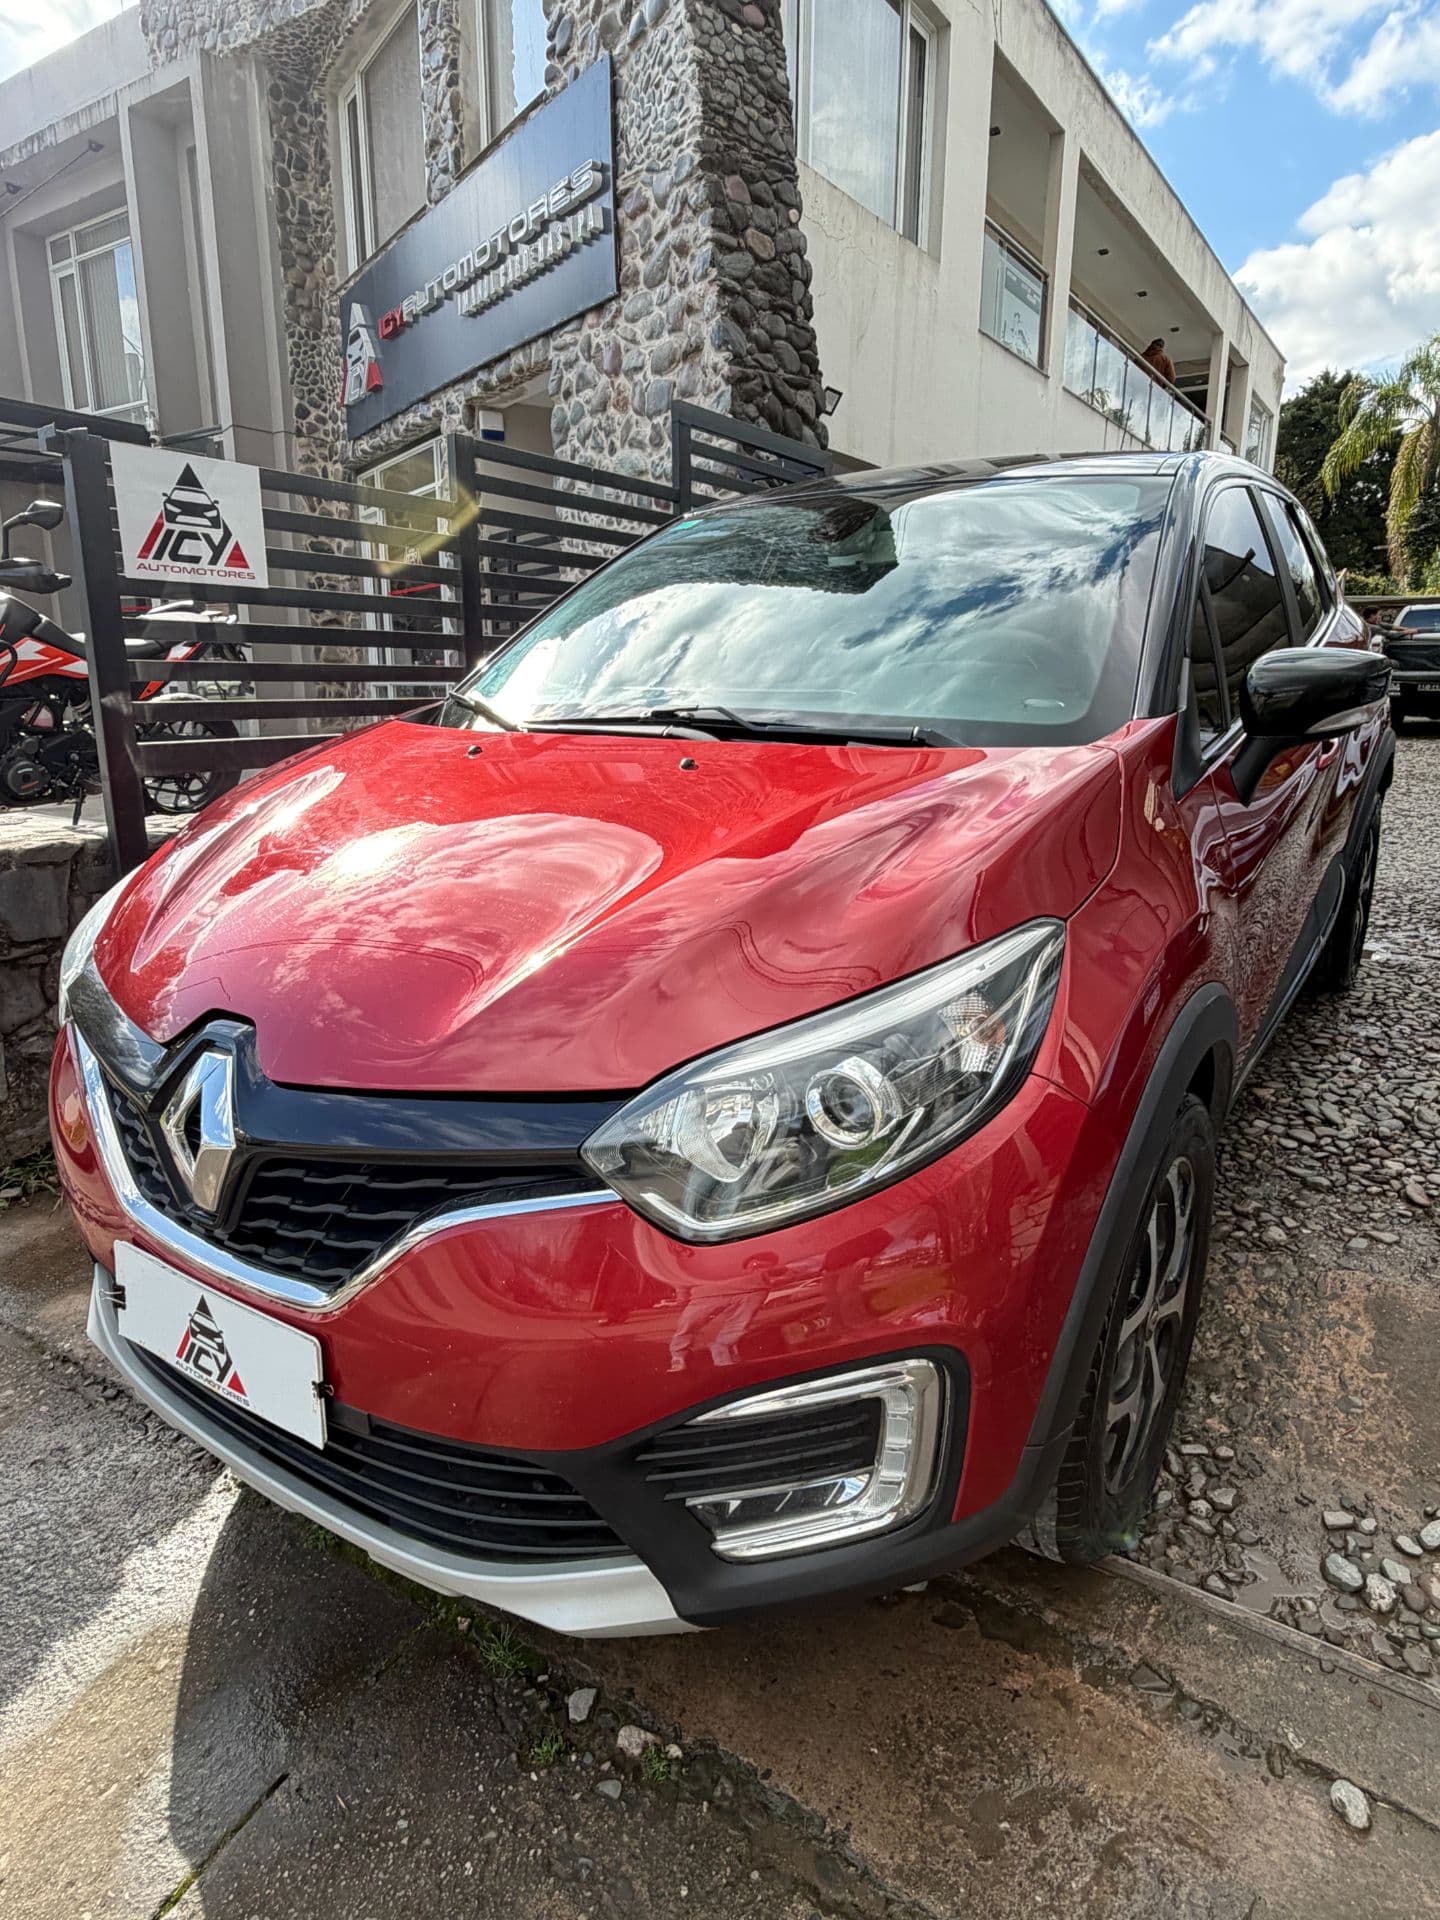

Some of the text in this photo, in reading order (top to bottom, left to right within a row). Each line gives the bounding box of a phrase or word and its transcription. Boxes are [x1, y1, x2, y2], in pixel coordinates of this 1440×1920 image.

[152, 517, 233, 566] ICY
[136, 562, 256, 580] AUTOMOTORES
[175, 1359, 250, 1407] AUTOMOTORES
[184, 1341, 233, 1384] ICY
